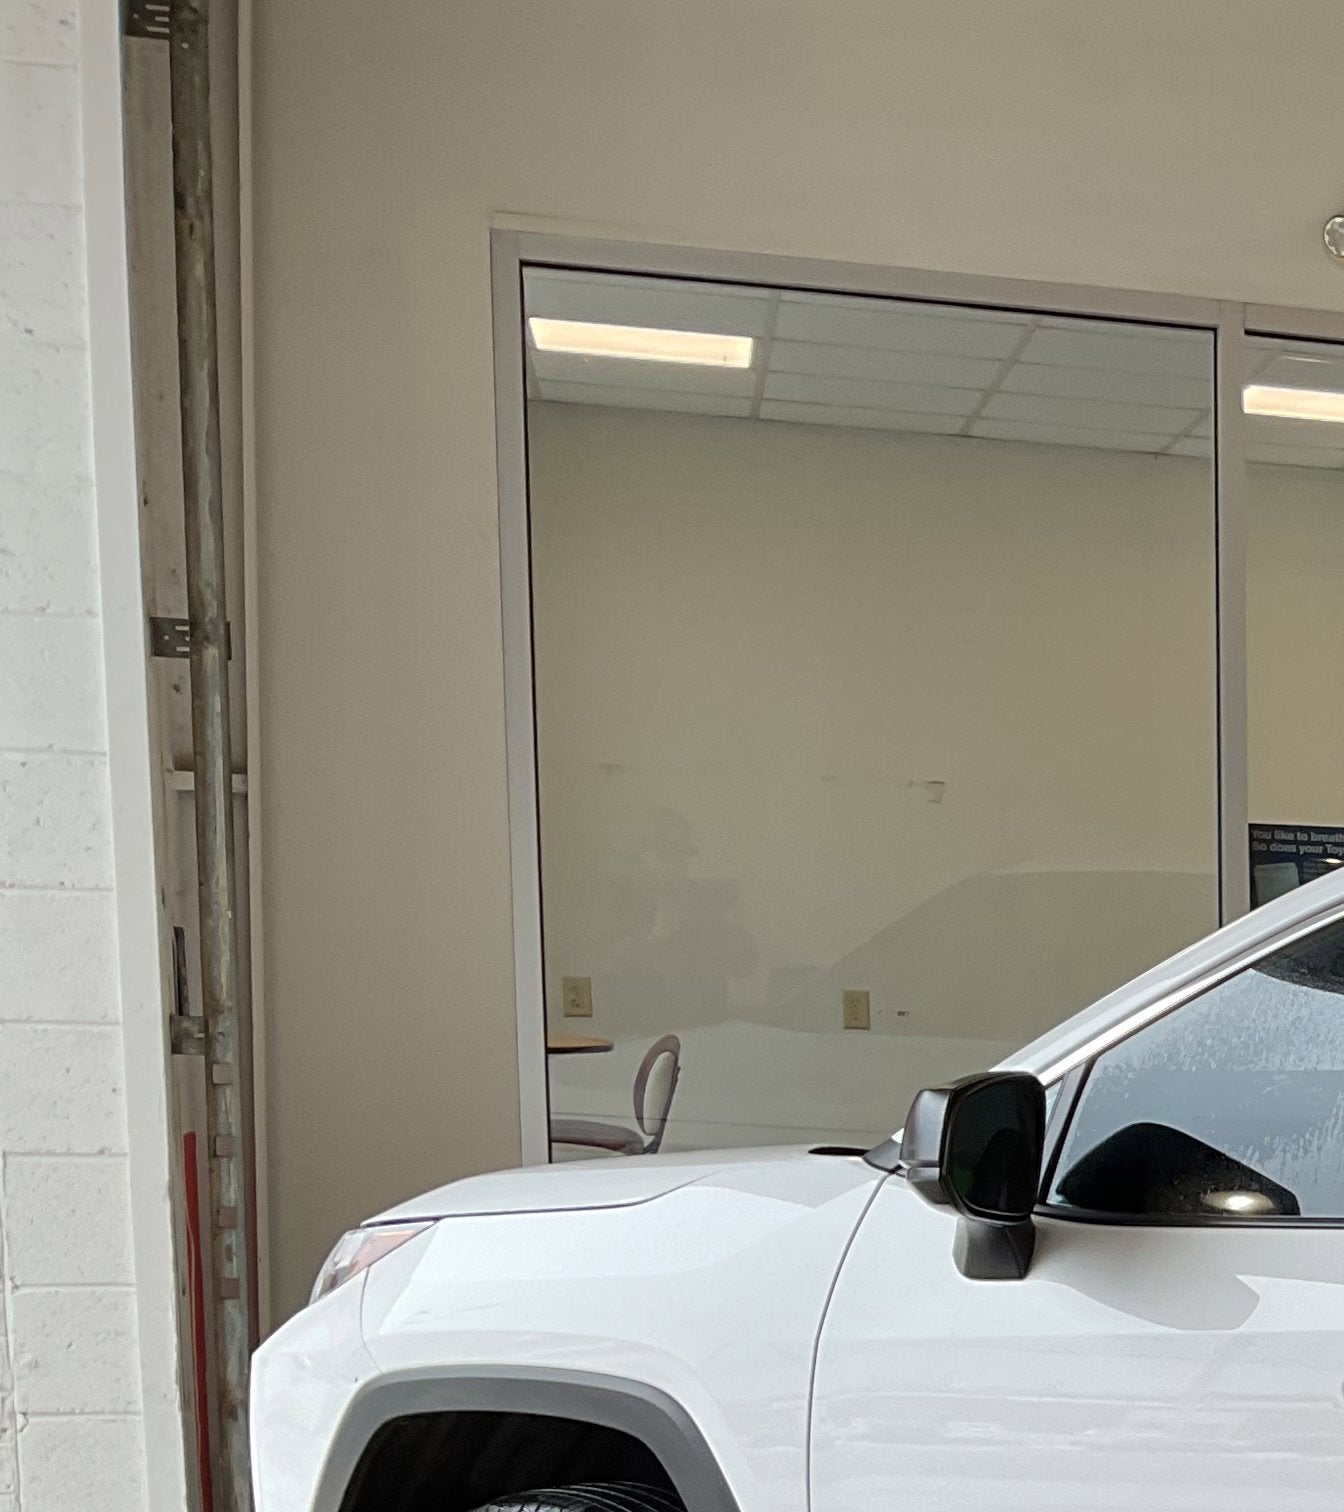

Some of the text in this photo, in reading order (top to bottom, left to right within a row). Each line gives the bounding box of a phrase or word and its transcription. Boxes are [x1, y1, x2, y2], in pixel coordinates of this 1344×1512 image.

[1252, 830, 1272, 840] You
[1274, 830, 1295, 841] like
[1297, 831, 1308, 841] to
[1253, 841, 1268, 852] So
[1270, 842, 1297, 853] does
[1299, 844, 1323, 855] your
